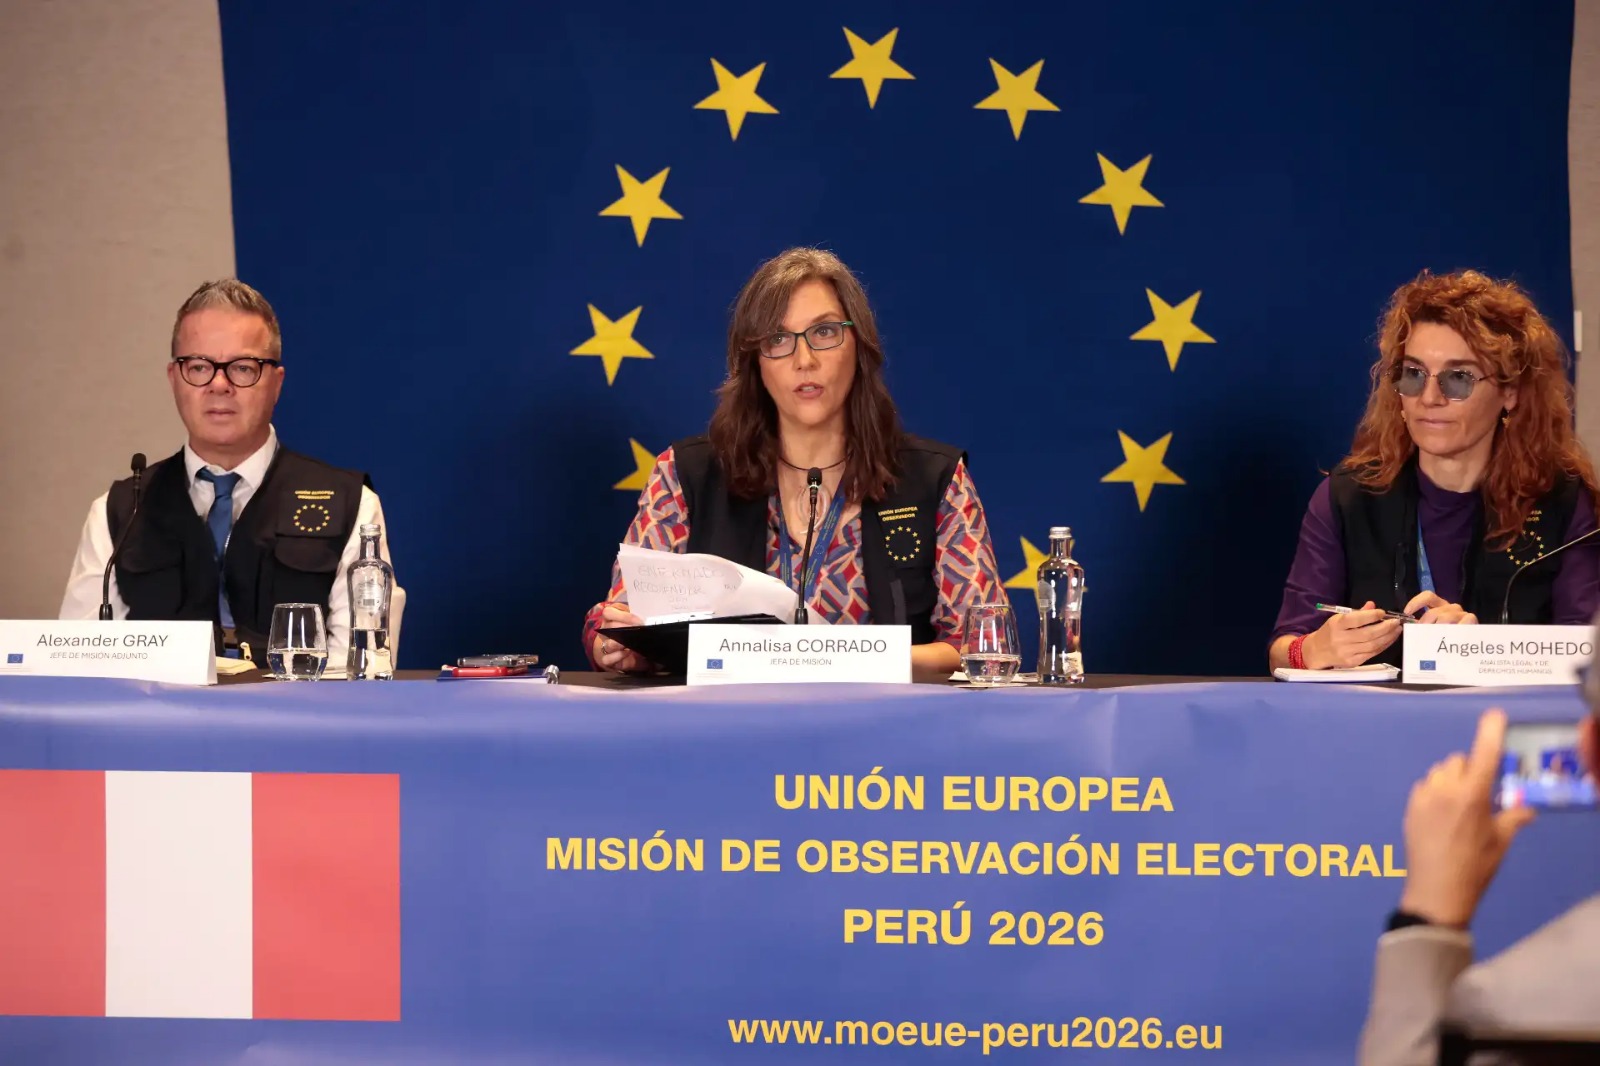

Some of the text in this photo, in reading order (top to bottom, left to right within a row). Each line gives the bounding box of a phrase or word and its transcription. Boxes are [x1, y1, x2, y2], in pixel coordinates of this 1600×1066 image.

[37, 634, 169, 647] Alexander GRAY
[719, 638, 887, 653] Annalisa CORRADO
[1437, 636, 1593, 657] Ángeles MOHEDO
[50, 651, 148, 660] JEFE DE MISIÓN ADJUNTO
[770, 657, 832, 666] JEFA DE MISIÓN
[774, 766, 1174, 812] UNIÓN EUROPEA
[546, 829, 1408, 878] MISIÓN DE OBSERVACIÓN ELECTORAL
[843, 901, 1105, 946] PERÚ 2026
[728, 1017, 1223, 1054] www.moeue-peru2026.eu
